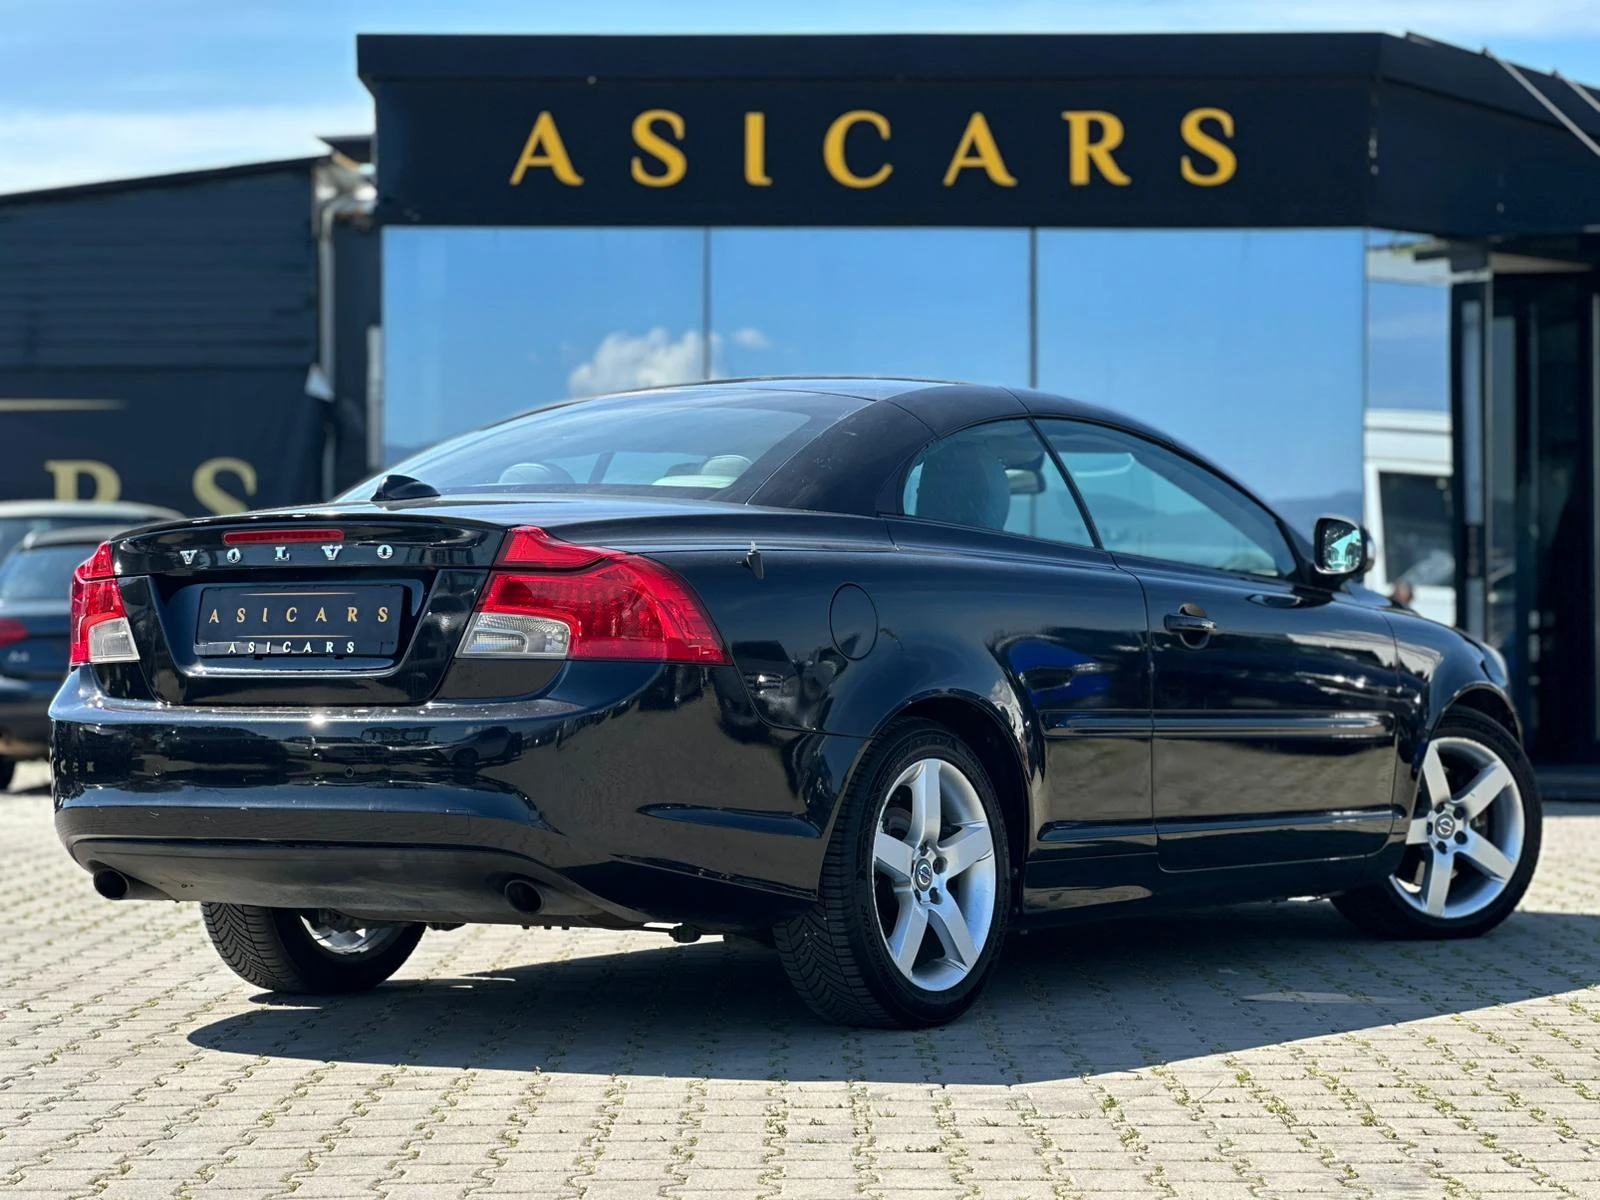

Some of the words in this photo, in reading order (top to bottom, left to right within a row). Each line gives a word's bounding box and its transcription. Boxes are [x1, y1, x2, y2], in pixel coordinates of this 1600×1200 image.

[508, 107, 1238, 189] ASICARS
[179, 544, 394, 565] VOLVO
[208, 606, 389, 624] ASICARS
[228, 641, 355, 654] ASICARS
